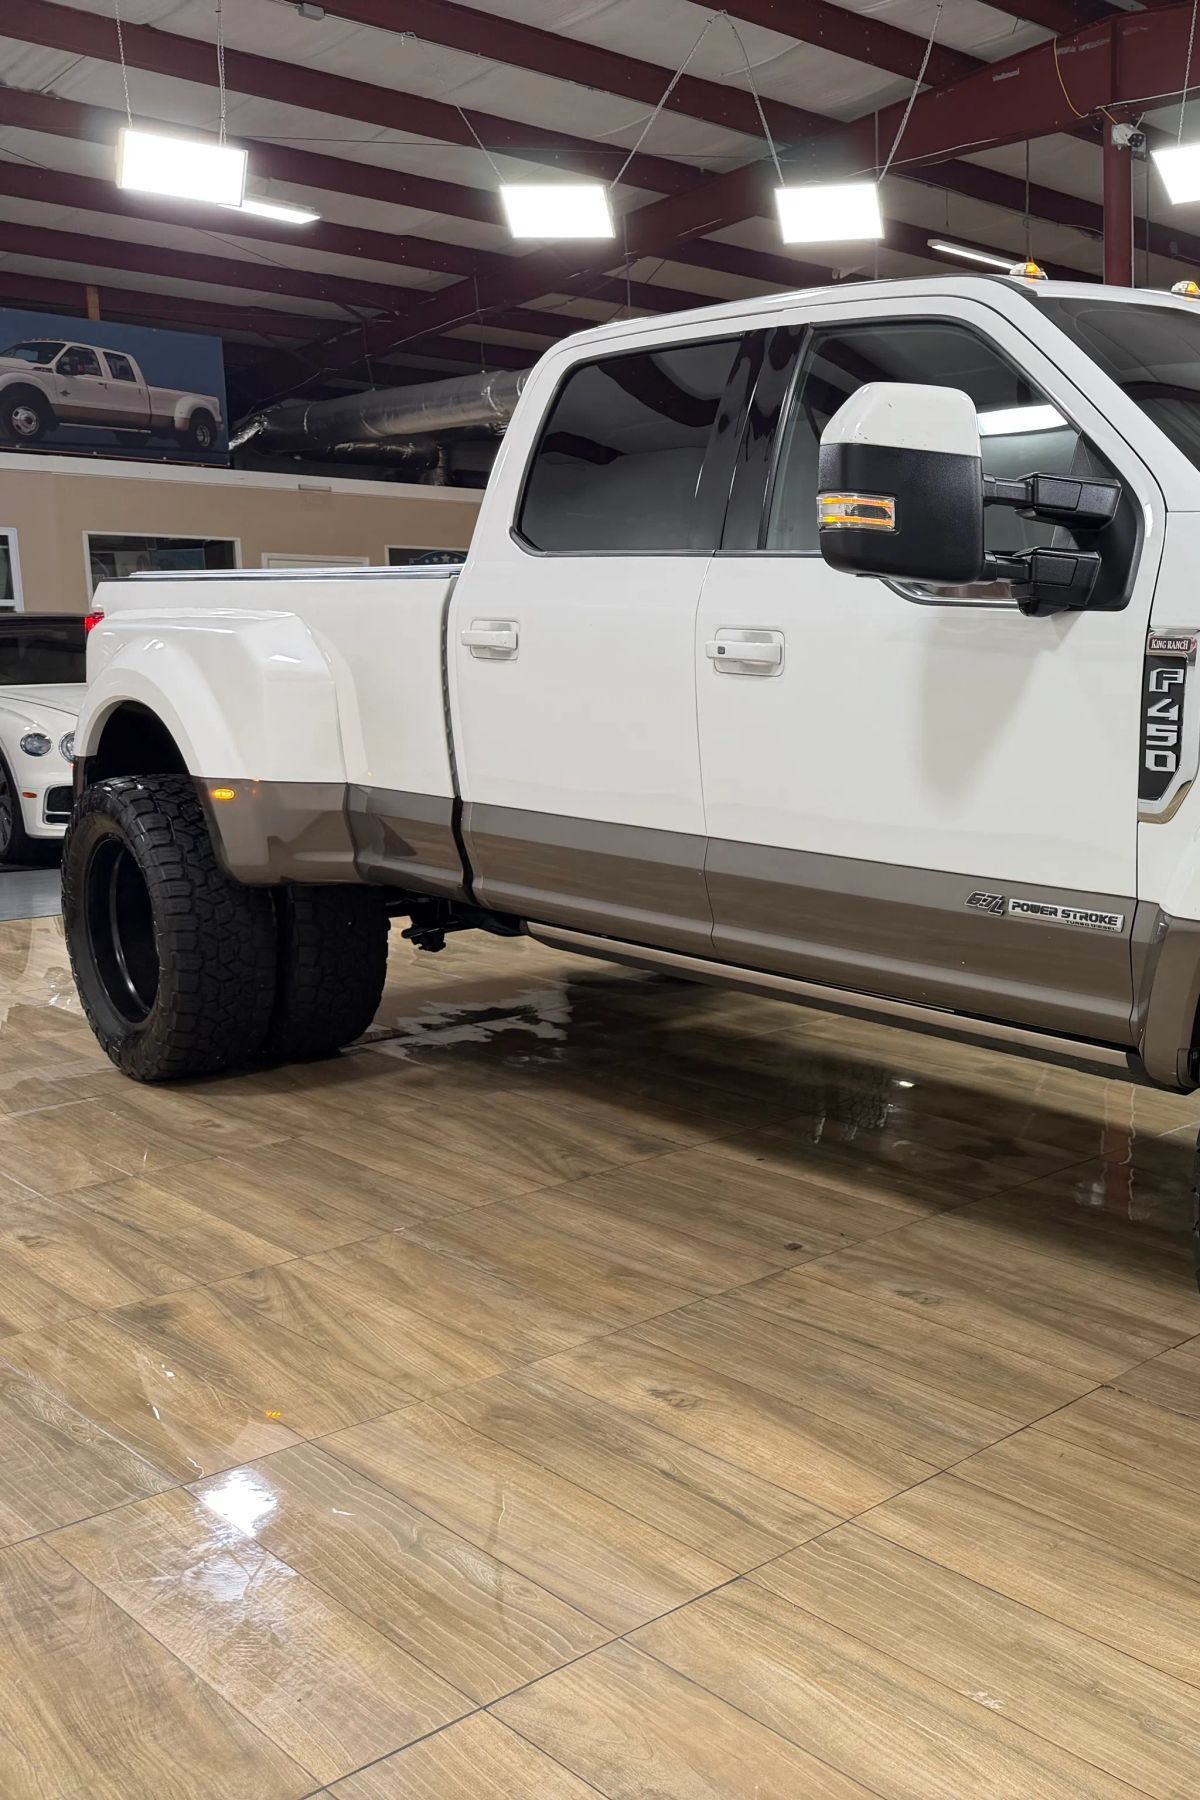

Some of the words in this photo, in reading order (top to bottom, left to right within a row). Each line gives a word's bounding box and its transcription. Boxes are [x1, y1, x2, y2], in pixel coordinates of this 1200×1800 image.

[1151, 638, 1167, 650] KING
[1167, 639, 1189, 650] RANCH
[1145, 667, 1185, 772] F450
[1011, 901, 1059, 917] POWER
[1060, 909, 1120, 927] STROKE
[1065, 919, 1090, 928] TURBO
